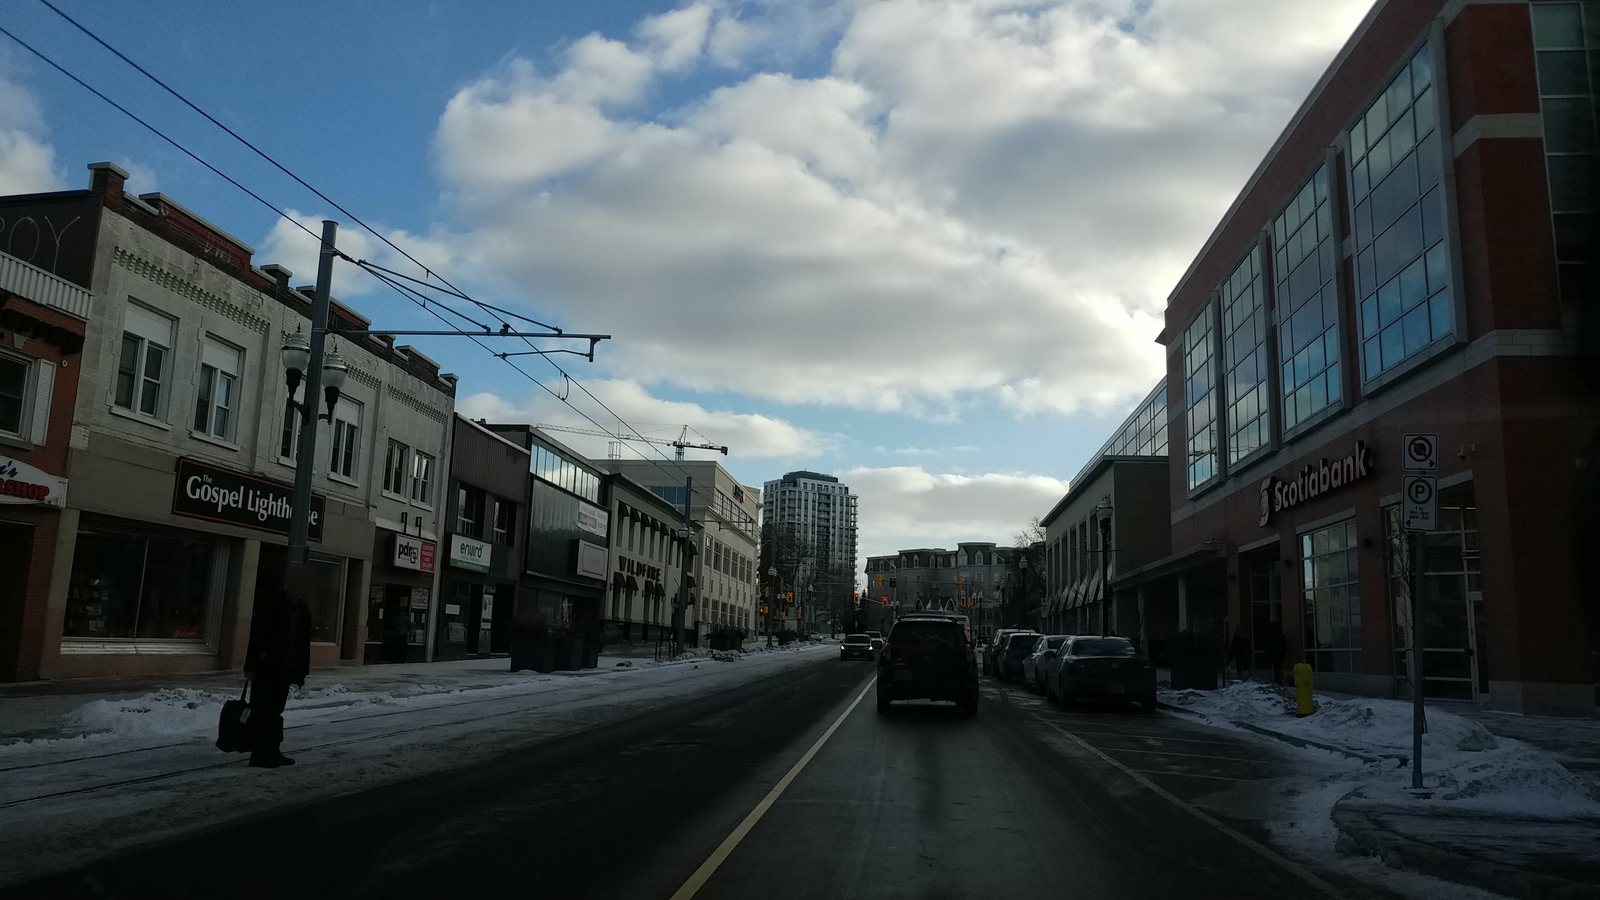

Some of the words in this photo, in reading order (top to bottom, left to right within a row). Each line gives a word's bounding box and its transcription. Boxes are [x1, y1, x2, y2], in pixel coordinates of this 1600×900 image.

[202, 474, 213, 484] The
[1274, 440, 1367, 512] Scotiabank
[186, 475, 244, 513] Gospel
[247, 489, 318, 525] Lighthe
[618, 555, 661, 582] WILDFIRE
